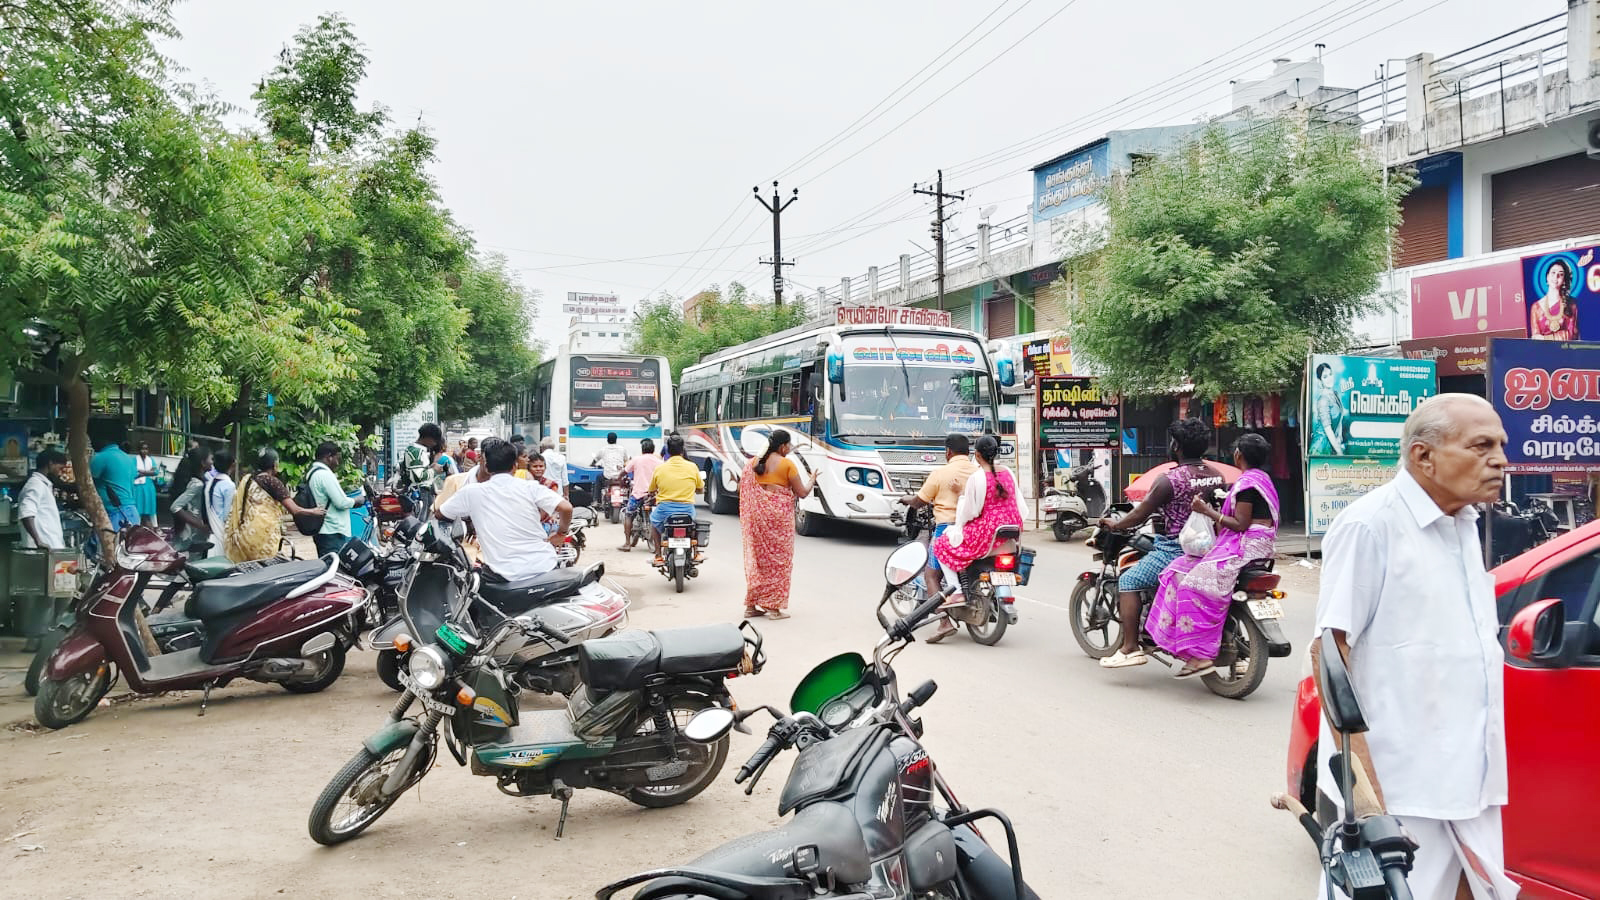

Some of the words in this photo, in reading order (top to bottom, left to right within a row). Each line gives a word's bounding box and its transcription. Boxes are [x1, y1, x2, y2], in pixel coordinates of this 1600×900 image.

[853, 343, 976, 365] வானவில்
[1042, 382, 1101, 408] தர்ஷினி
[1530, 414, 1600, 434] சில்க்
[1190, 476, 1222, 487] BASKAR
